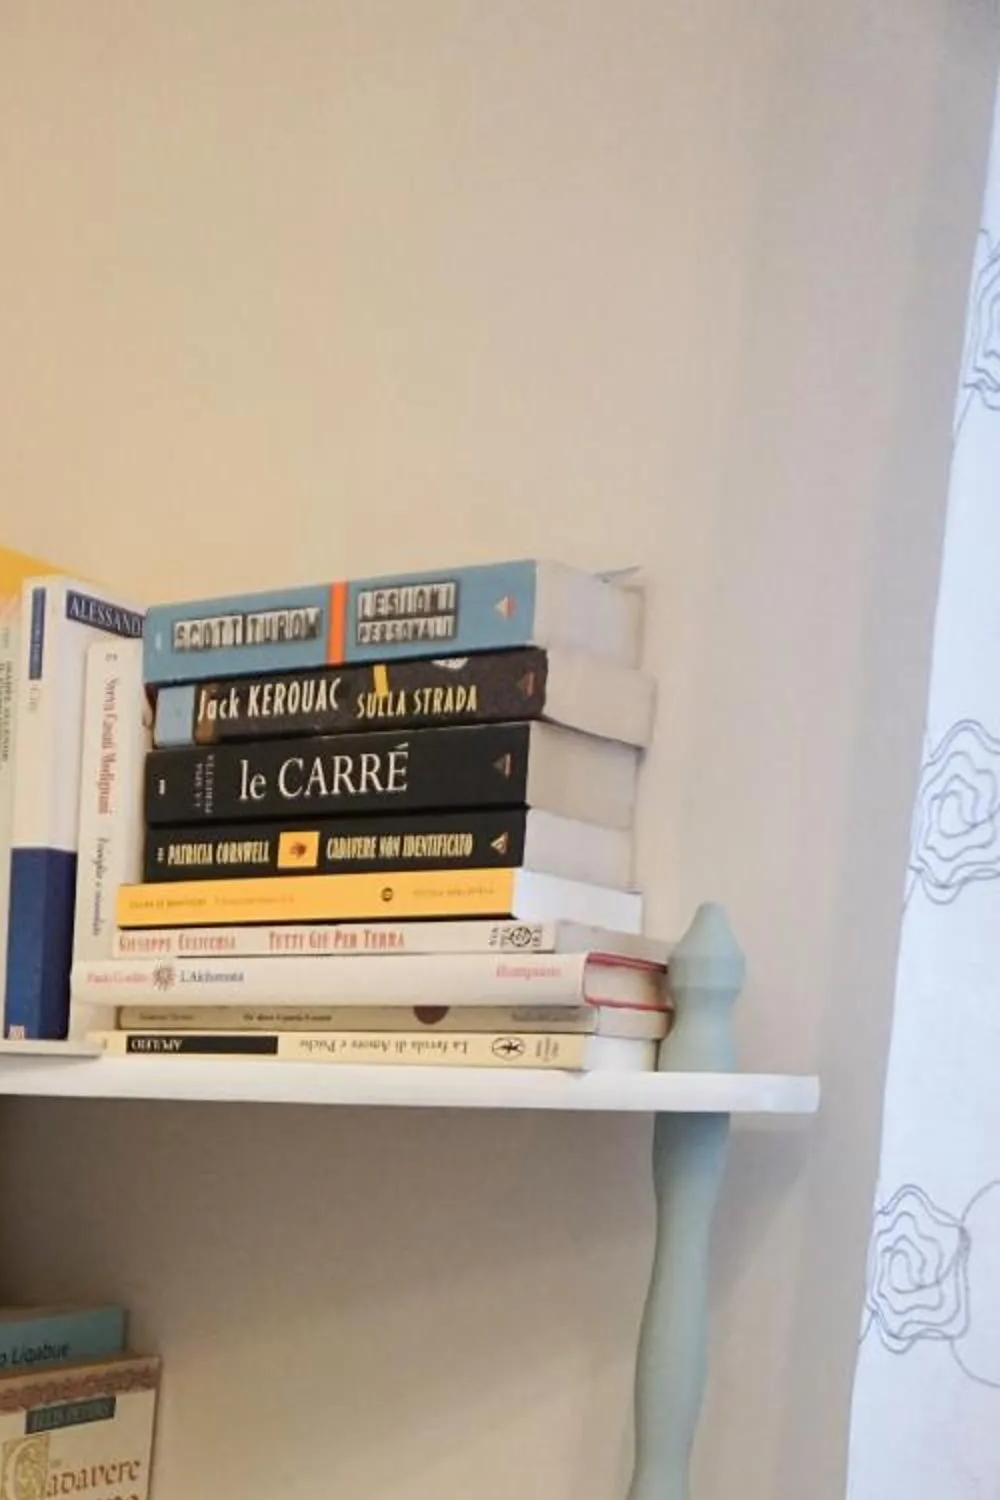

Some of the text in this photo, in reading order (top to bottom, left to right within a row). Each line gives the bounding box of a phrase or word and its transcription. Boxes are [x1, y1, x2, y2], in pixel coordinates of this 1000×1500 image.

[69, 595, 145, 637] ALESSAND
[358, 582, 456, 618] LESIONI
[175, 606, 320, 649] SCOTT TUROW
[197, 677, 342, 722] Jack KEROUAC
[357, 684, 478, 719] SULLA STRADA
[239, 741, 410, 800] le CARRÉ
[167, 840, 270, 865] PATRICIA CORNWELL
[326, 833, 473, 860] CADAVERE NON IDENTIFICATO
[11, 1341, 71, 1366] Ligabue
